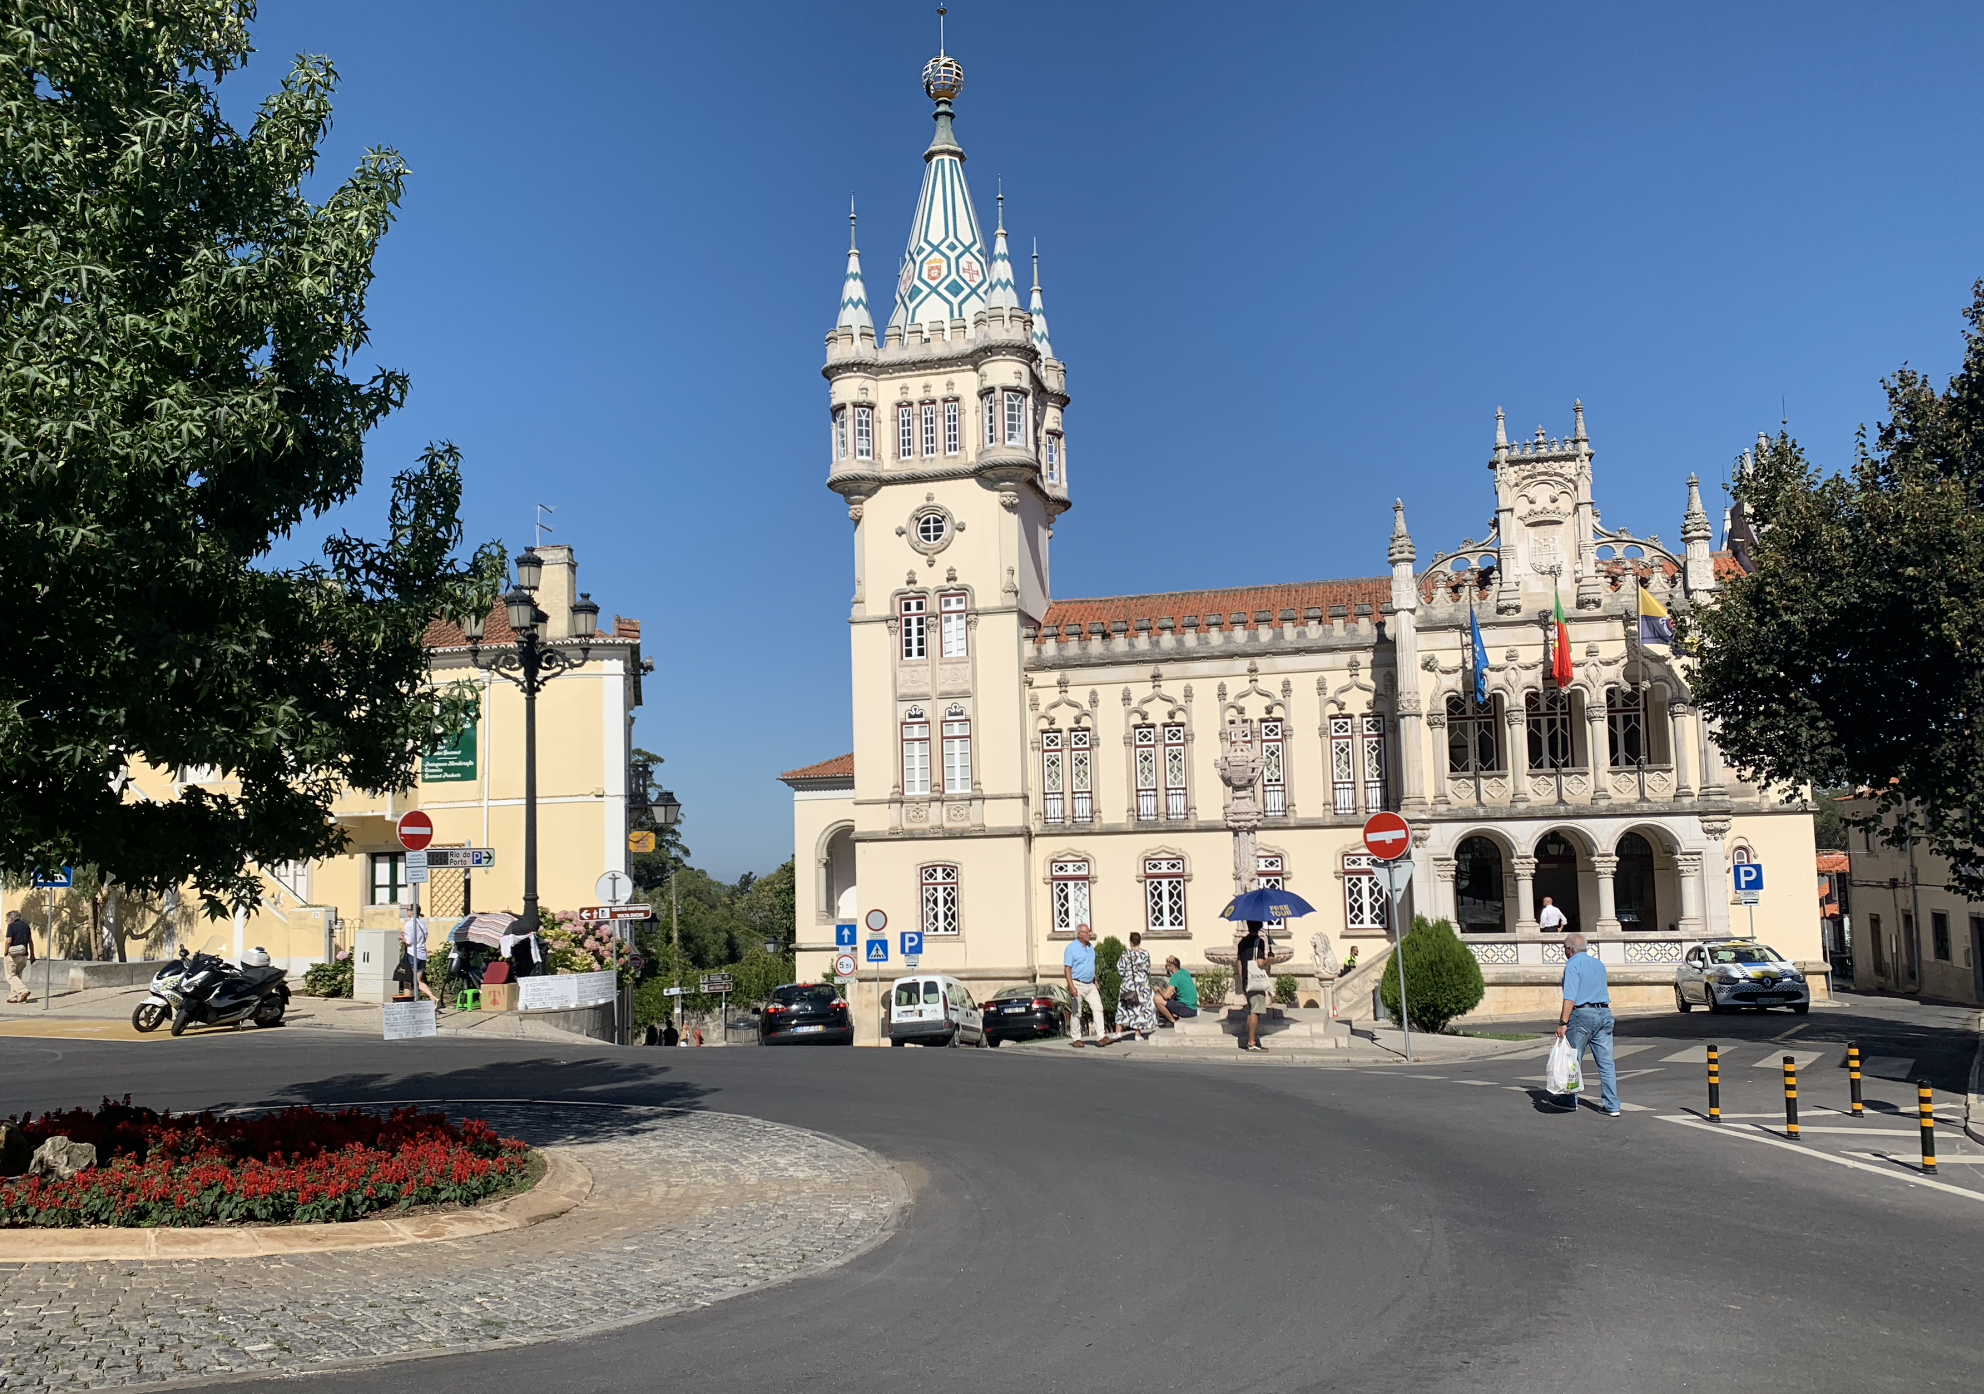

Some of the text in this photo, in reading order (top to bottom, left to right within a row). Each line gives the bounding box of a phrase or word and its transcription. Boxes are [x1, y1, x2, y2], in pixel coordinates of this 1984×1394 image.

[473, 852, 480, 864] P
[1740, 867, 1757, 888] P
[905, 934, 918, 953] P
